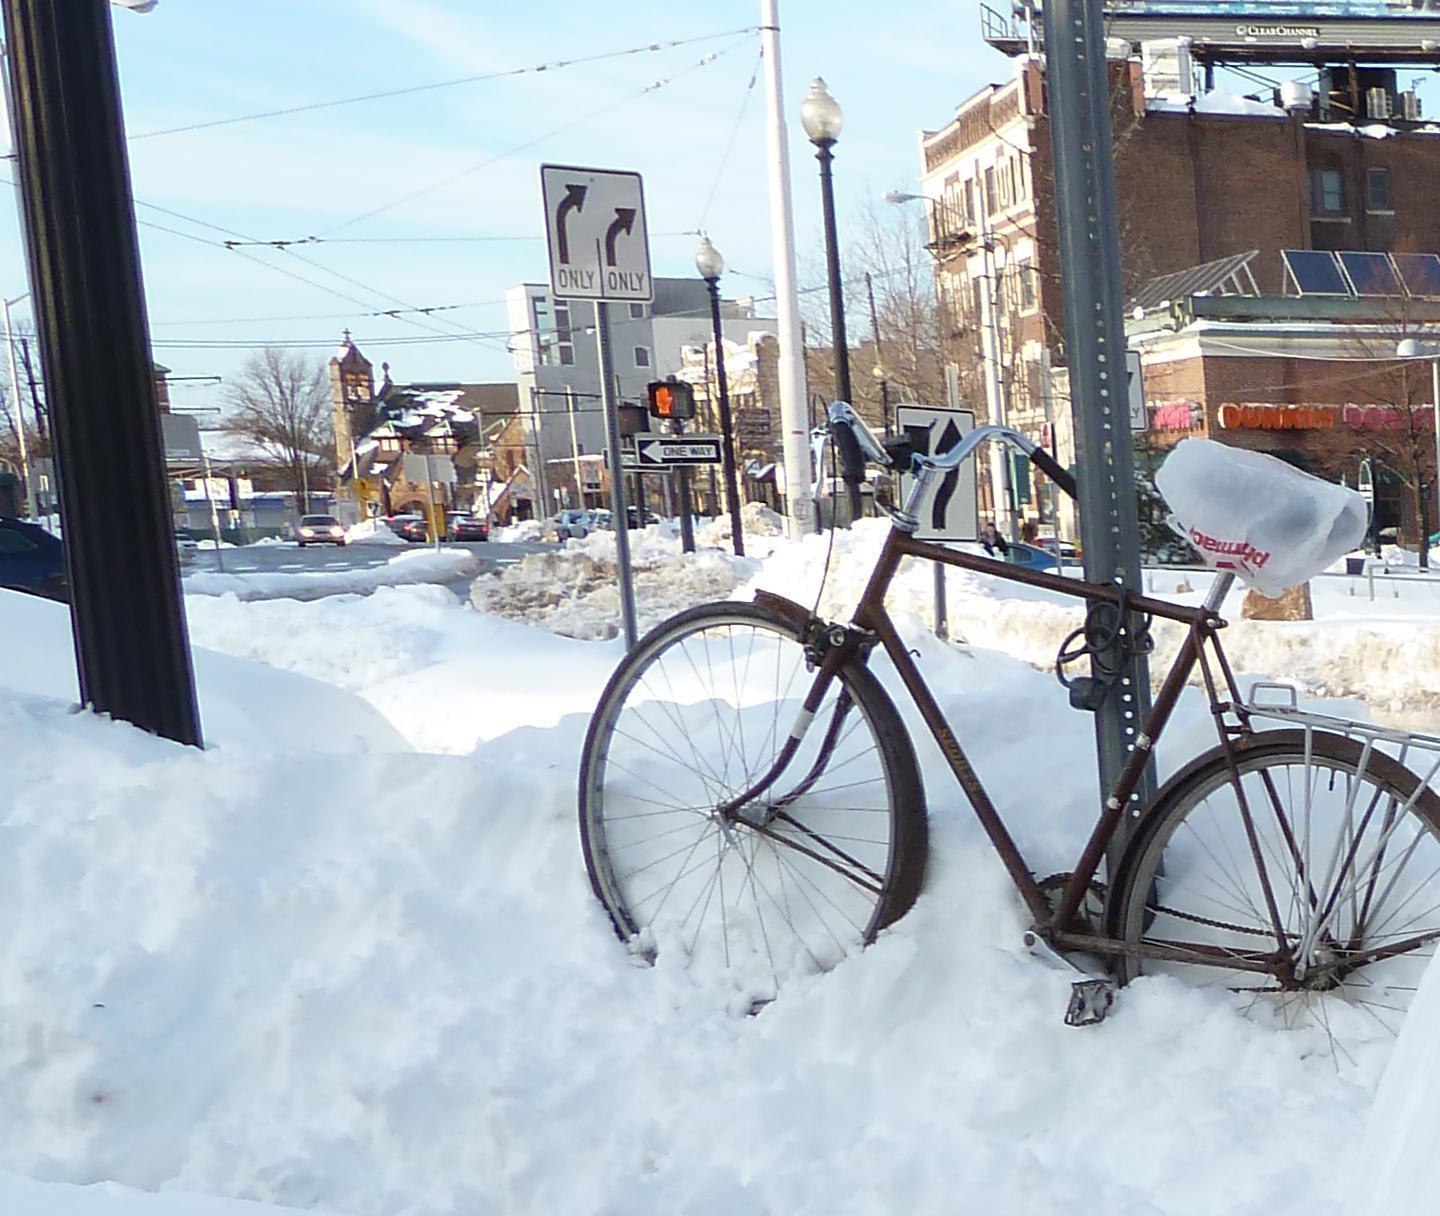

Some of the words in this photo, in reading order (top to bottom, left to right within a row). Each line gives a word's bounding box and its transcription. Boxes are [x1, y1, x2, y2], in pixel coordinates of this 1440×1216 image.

[558, 269, 594, 289] ONLY
[607, 271, 644, 291] ONLY
[663, 447, 687, 456] ONE
[690, 447, 713, 456] WAY
